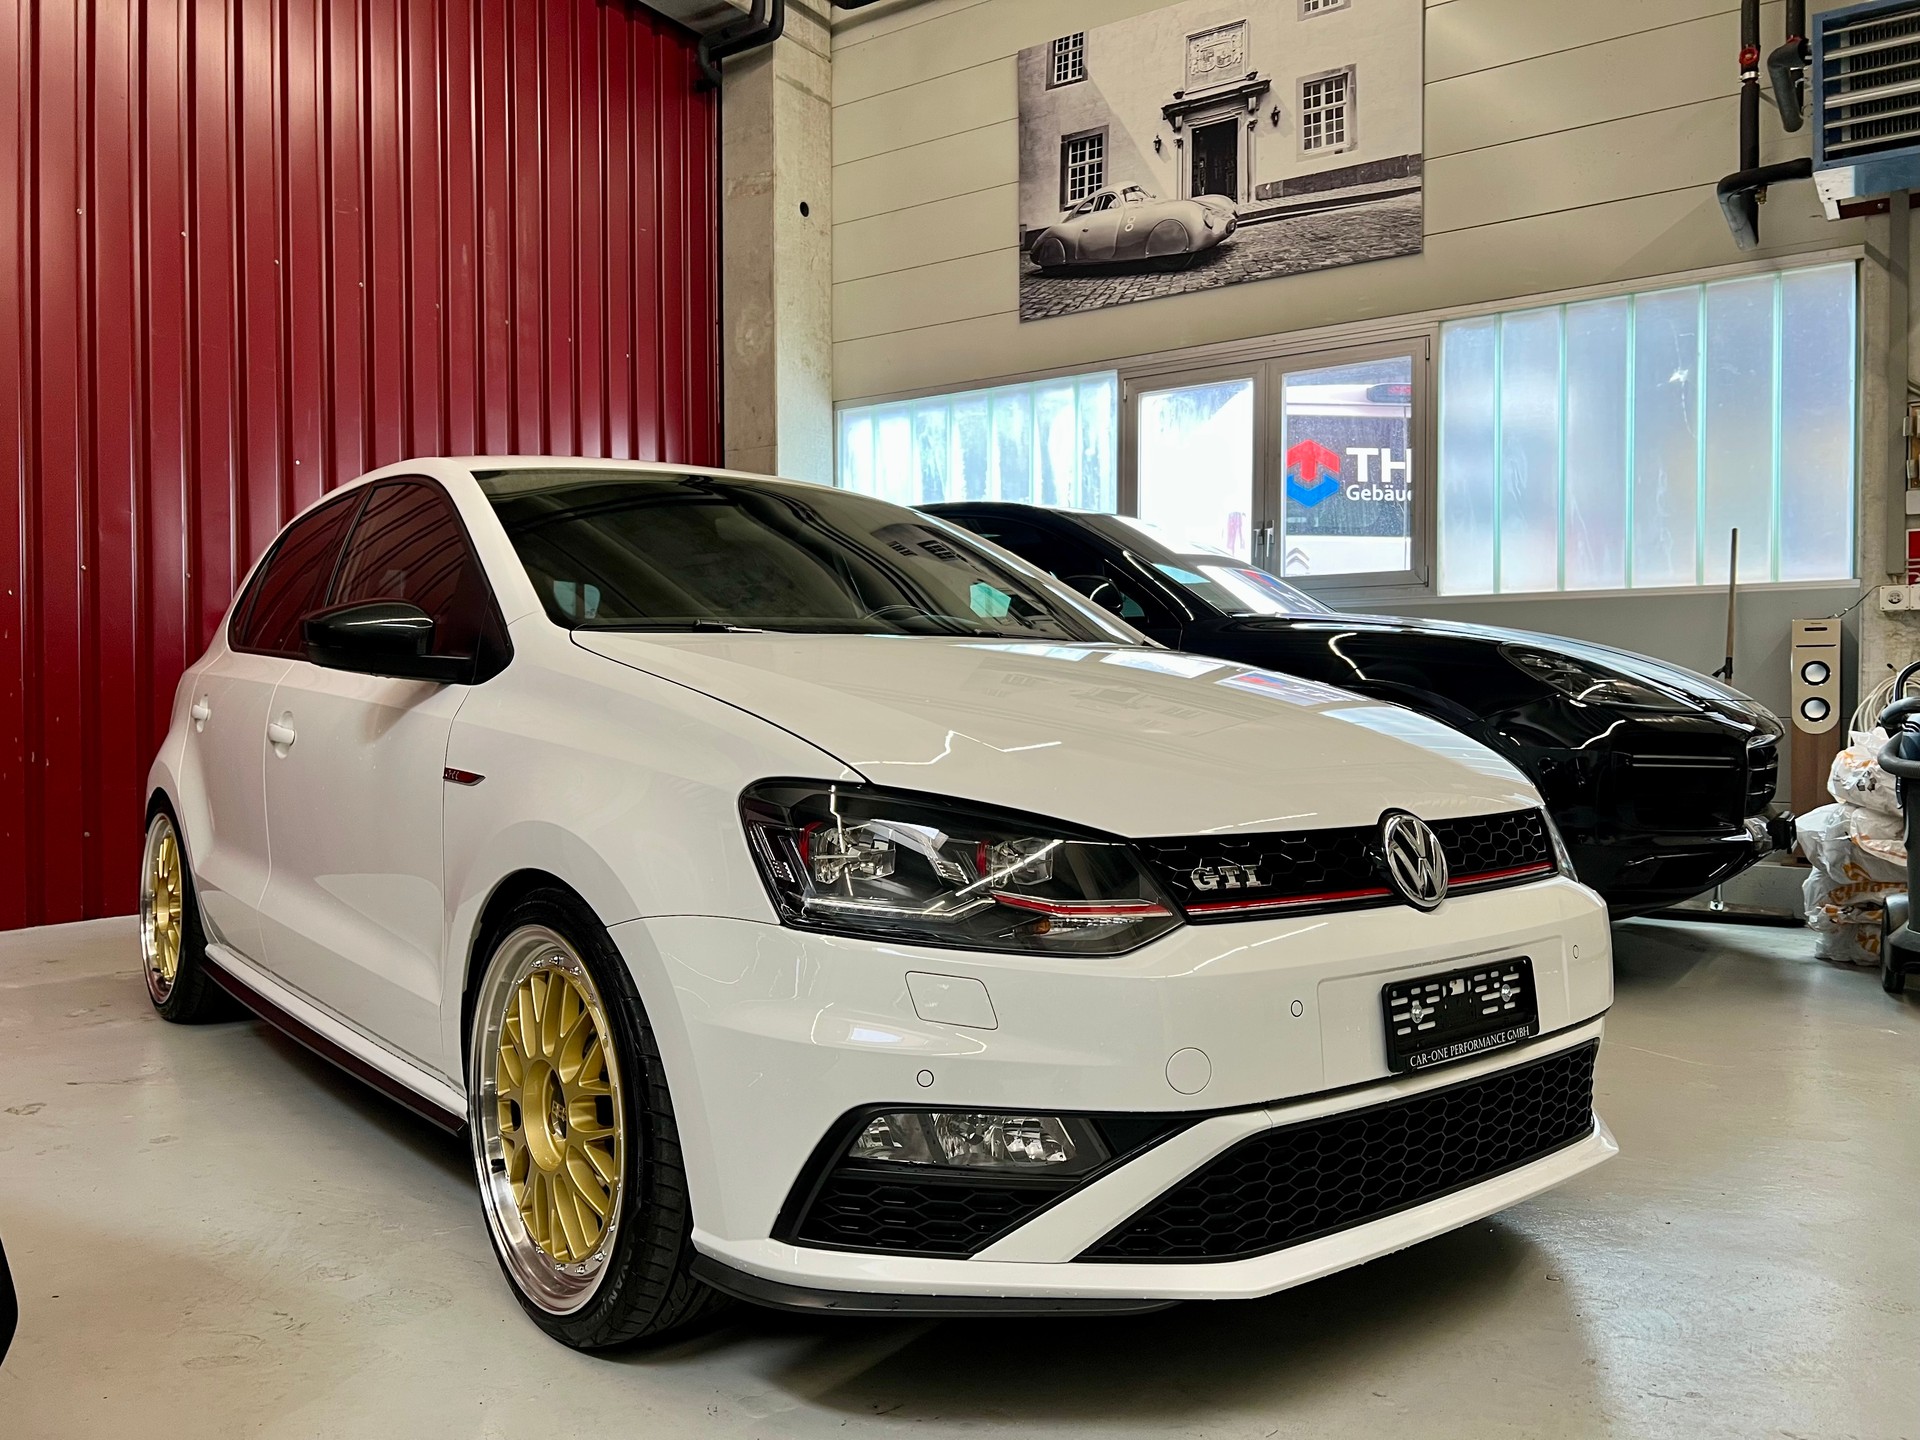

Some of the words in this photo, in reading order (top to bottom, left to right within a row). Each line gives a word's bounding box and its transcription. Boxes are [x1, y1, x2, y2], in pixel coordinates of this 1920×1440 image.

[1346, 448, 1412, 483] TH
[1191, 865, 1262, 891] GTI
[1410, 1047, 1449, 1067] CAR-ONE
[1450, 1032, 1506, 1057] PERFORMANCE
[1507, 1025, 1530, 1041] GMBH
